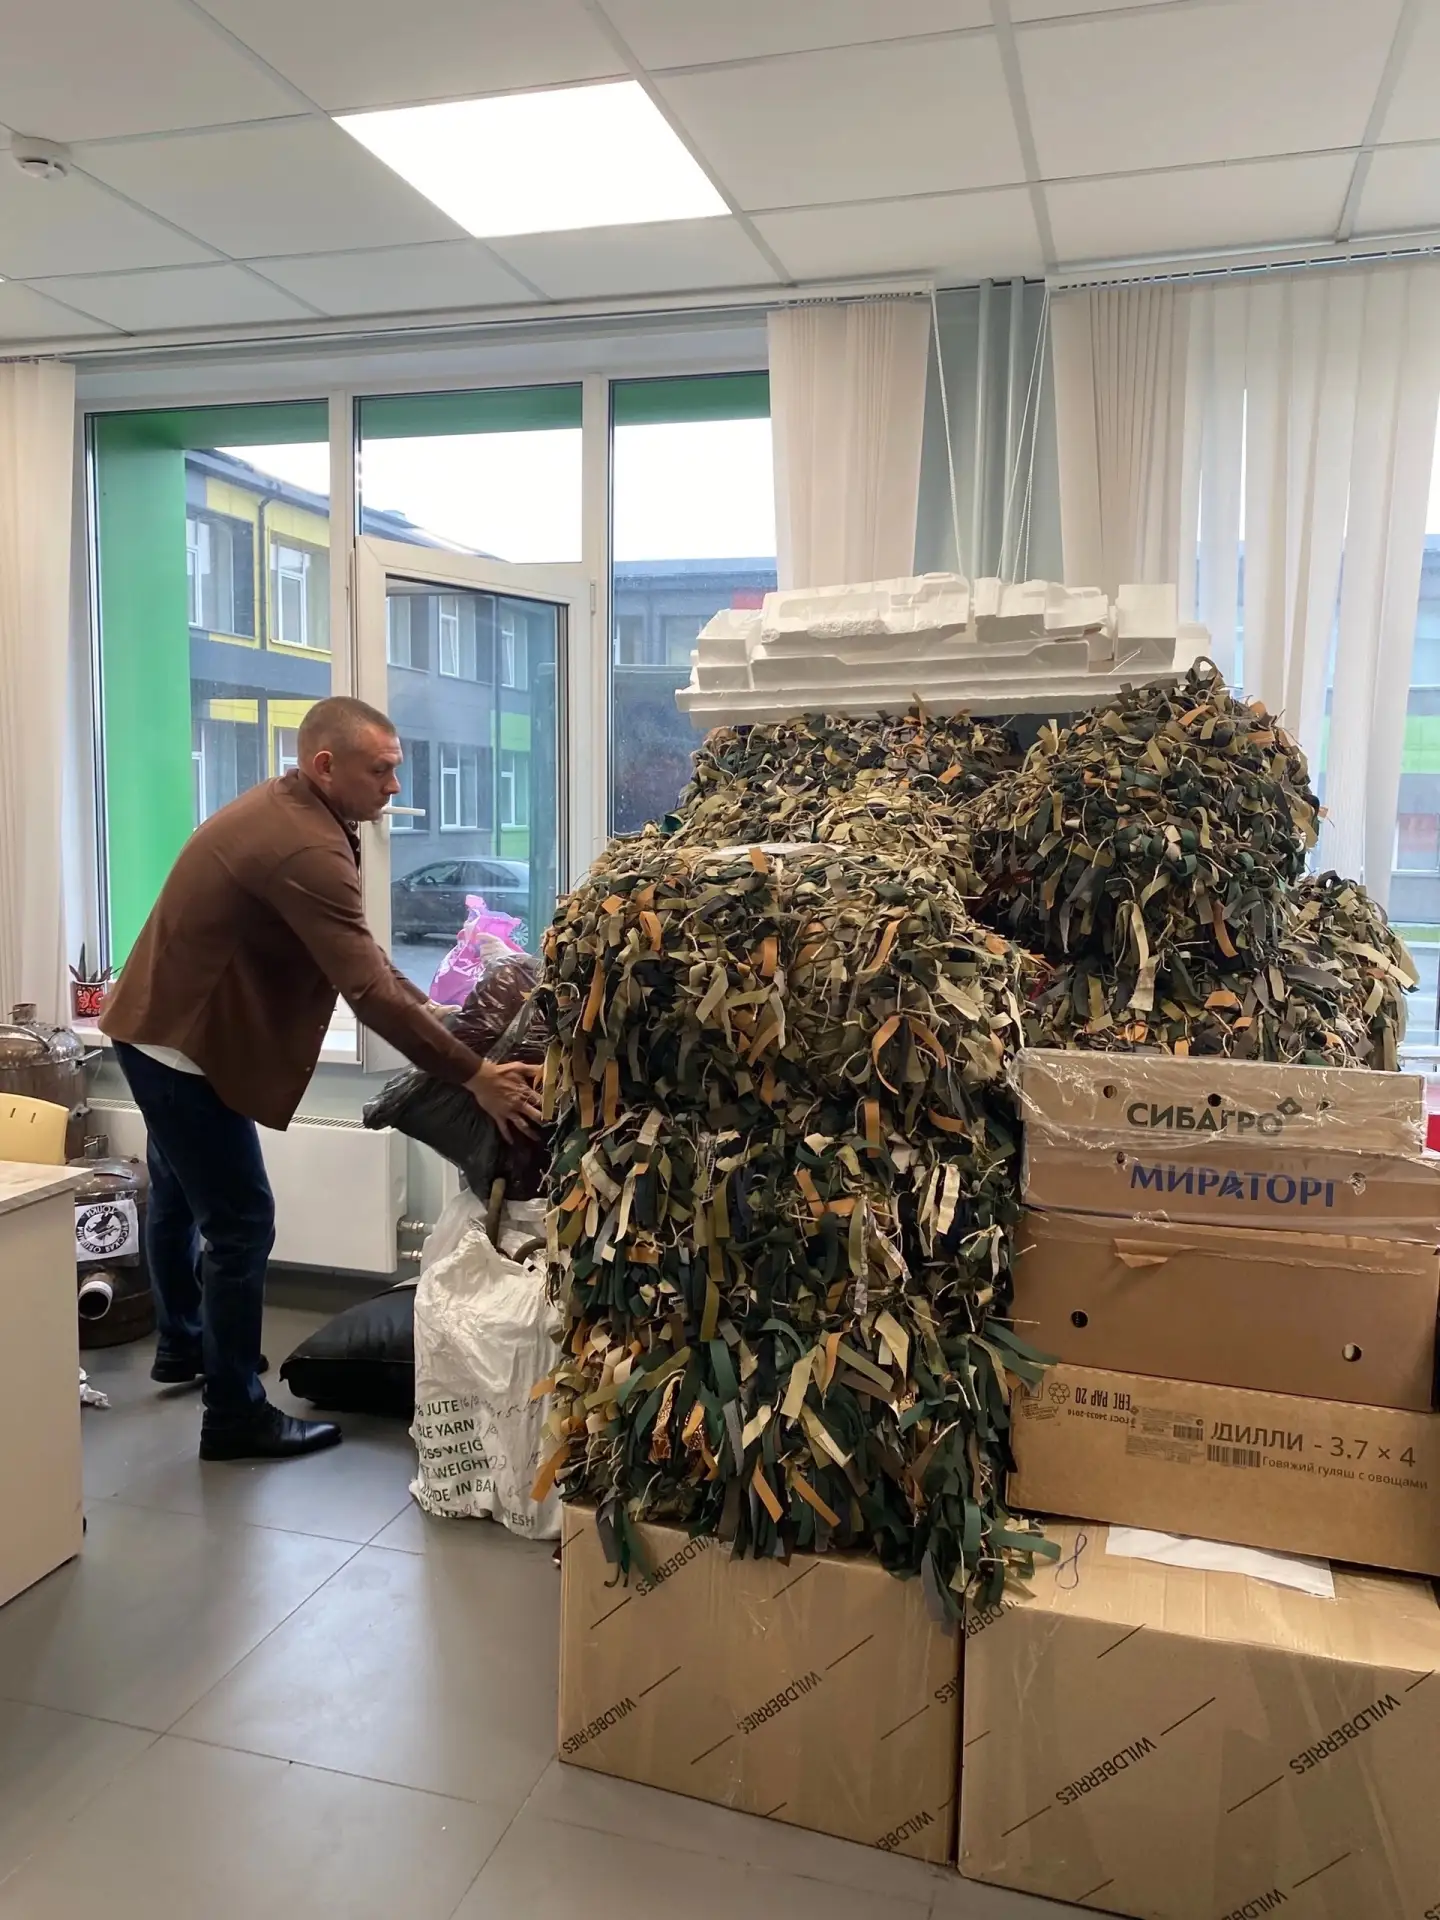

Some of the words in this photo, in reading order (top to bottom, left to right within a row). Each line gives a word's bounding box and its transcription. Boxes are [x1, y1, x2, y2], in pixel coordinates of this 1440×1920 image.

[1127, 1102, 1283, 1136] СИБАГРО
[426, 1399, 459, 1416] JUTE
[1075, 1387, 1087, 1404] 20
[1090, 1390, 1108, 1408] PAP
[435, 1418, 475, 1437] YARN
[1330, 1436, 1368, 1460] 3.7
[1399, 1446, 1416, 1468] 4
[433, 1458, 490, 1479] WEIGHT
[1262, 1455, 1315, 1474] Говяжий
[1317, 1465, 1355, 1480] гуляш
[1367, 1472, 1428, 1490] овощами
[456, 1480, 472, 1496] IN
[736, 1671, 822, 1735] WILDBERRIES
[562, 1697, 637, 1754] WILDBERRIES
[1289, 1694, 1401, 1775] WILDBERRIES
[1055, 1735, 1157, 1806] WILDBERRIES
